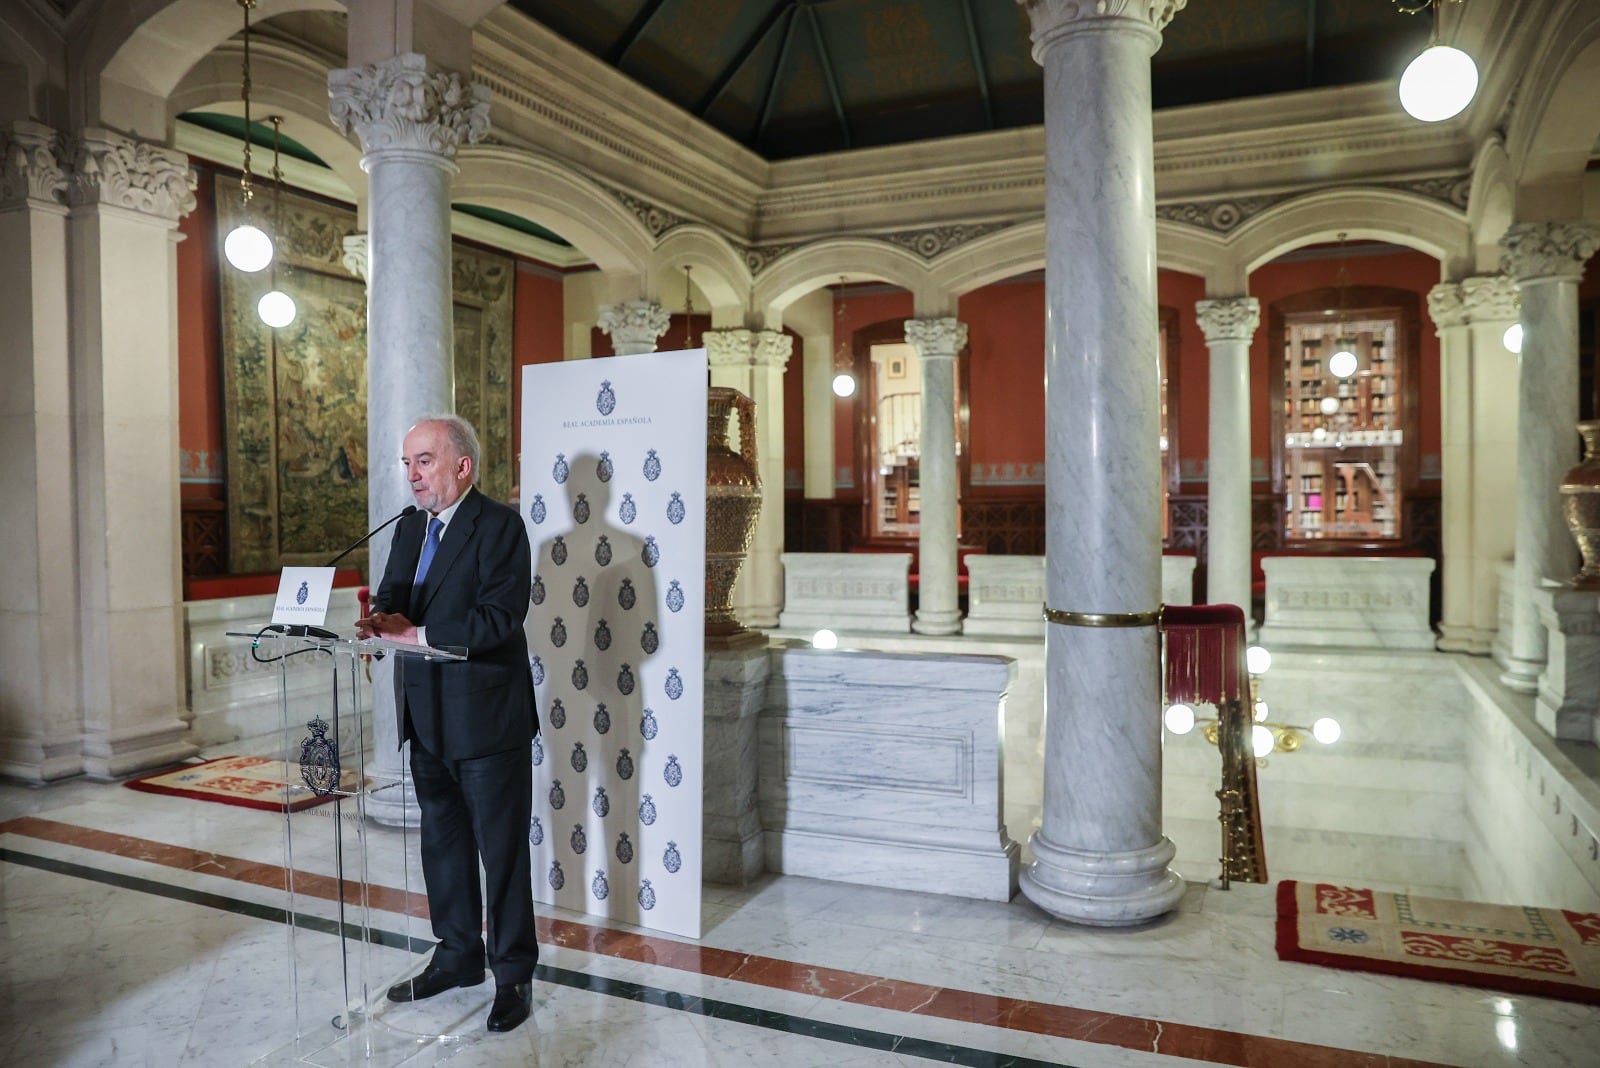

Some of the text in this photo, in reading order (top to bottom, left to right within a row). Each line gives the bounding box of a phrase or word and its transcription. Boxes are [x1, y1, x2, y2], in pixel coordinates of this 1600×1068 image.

[563, 415, 652, 428] REAL ACADEMIA ESPAÑOLA
